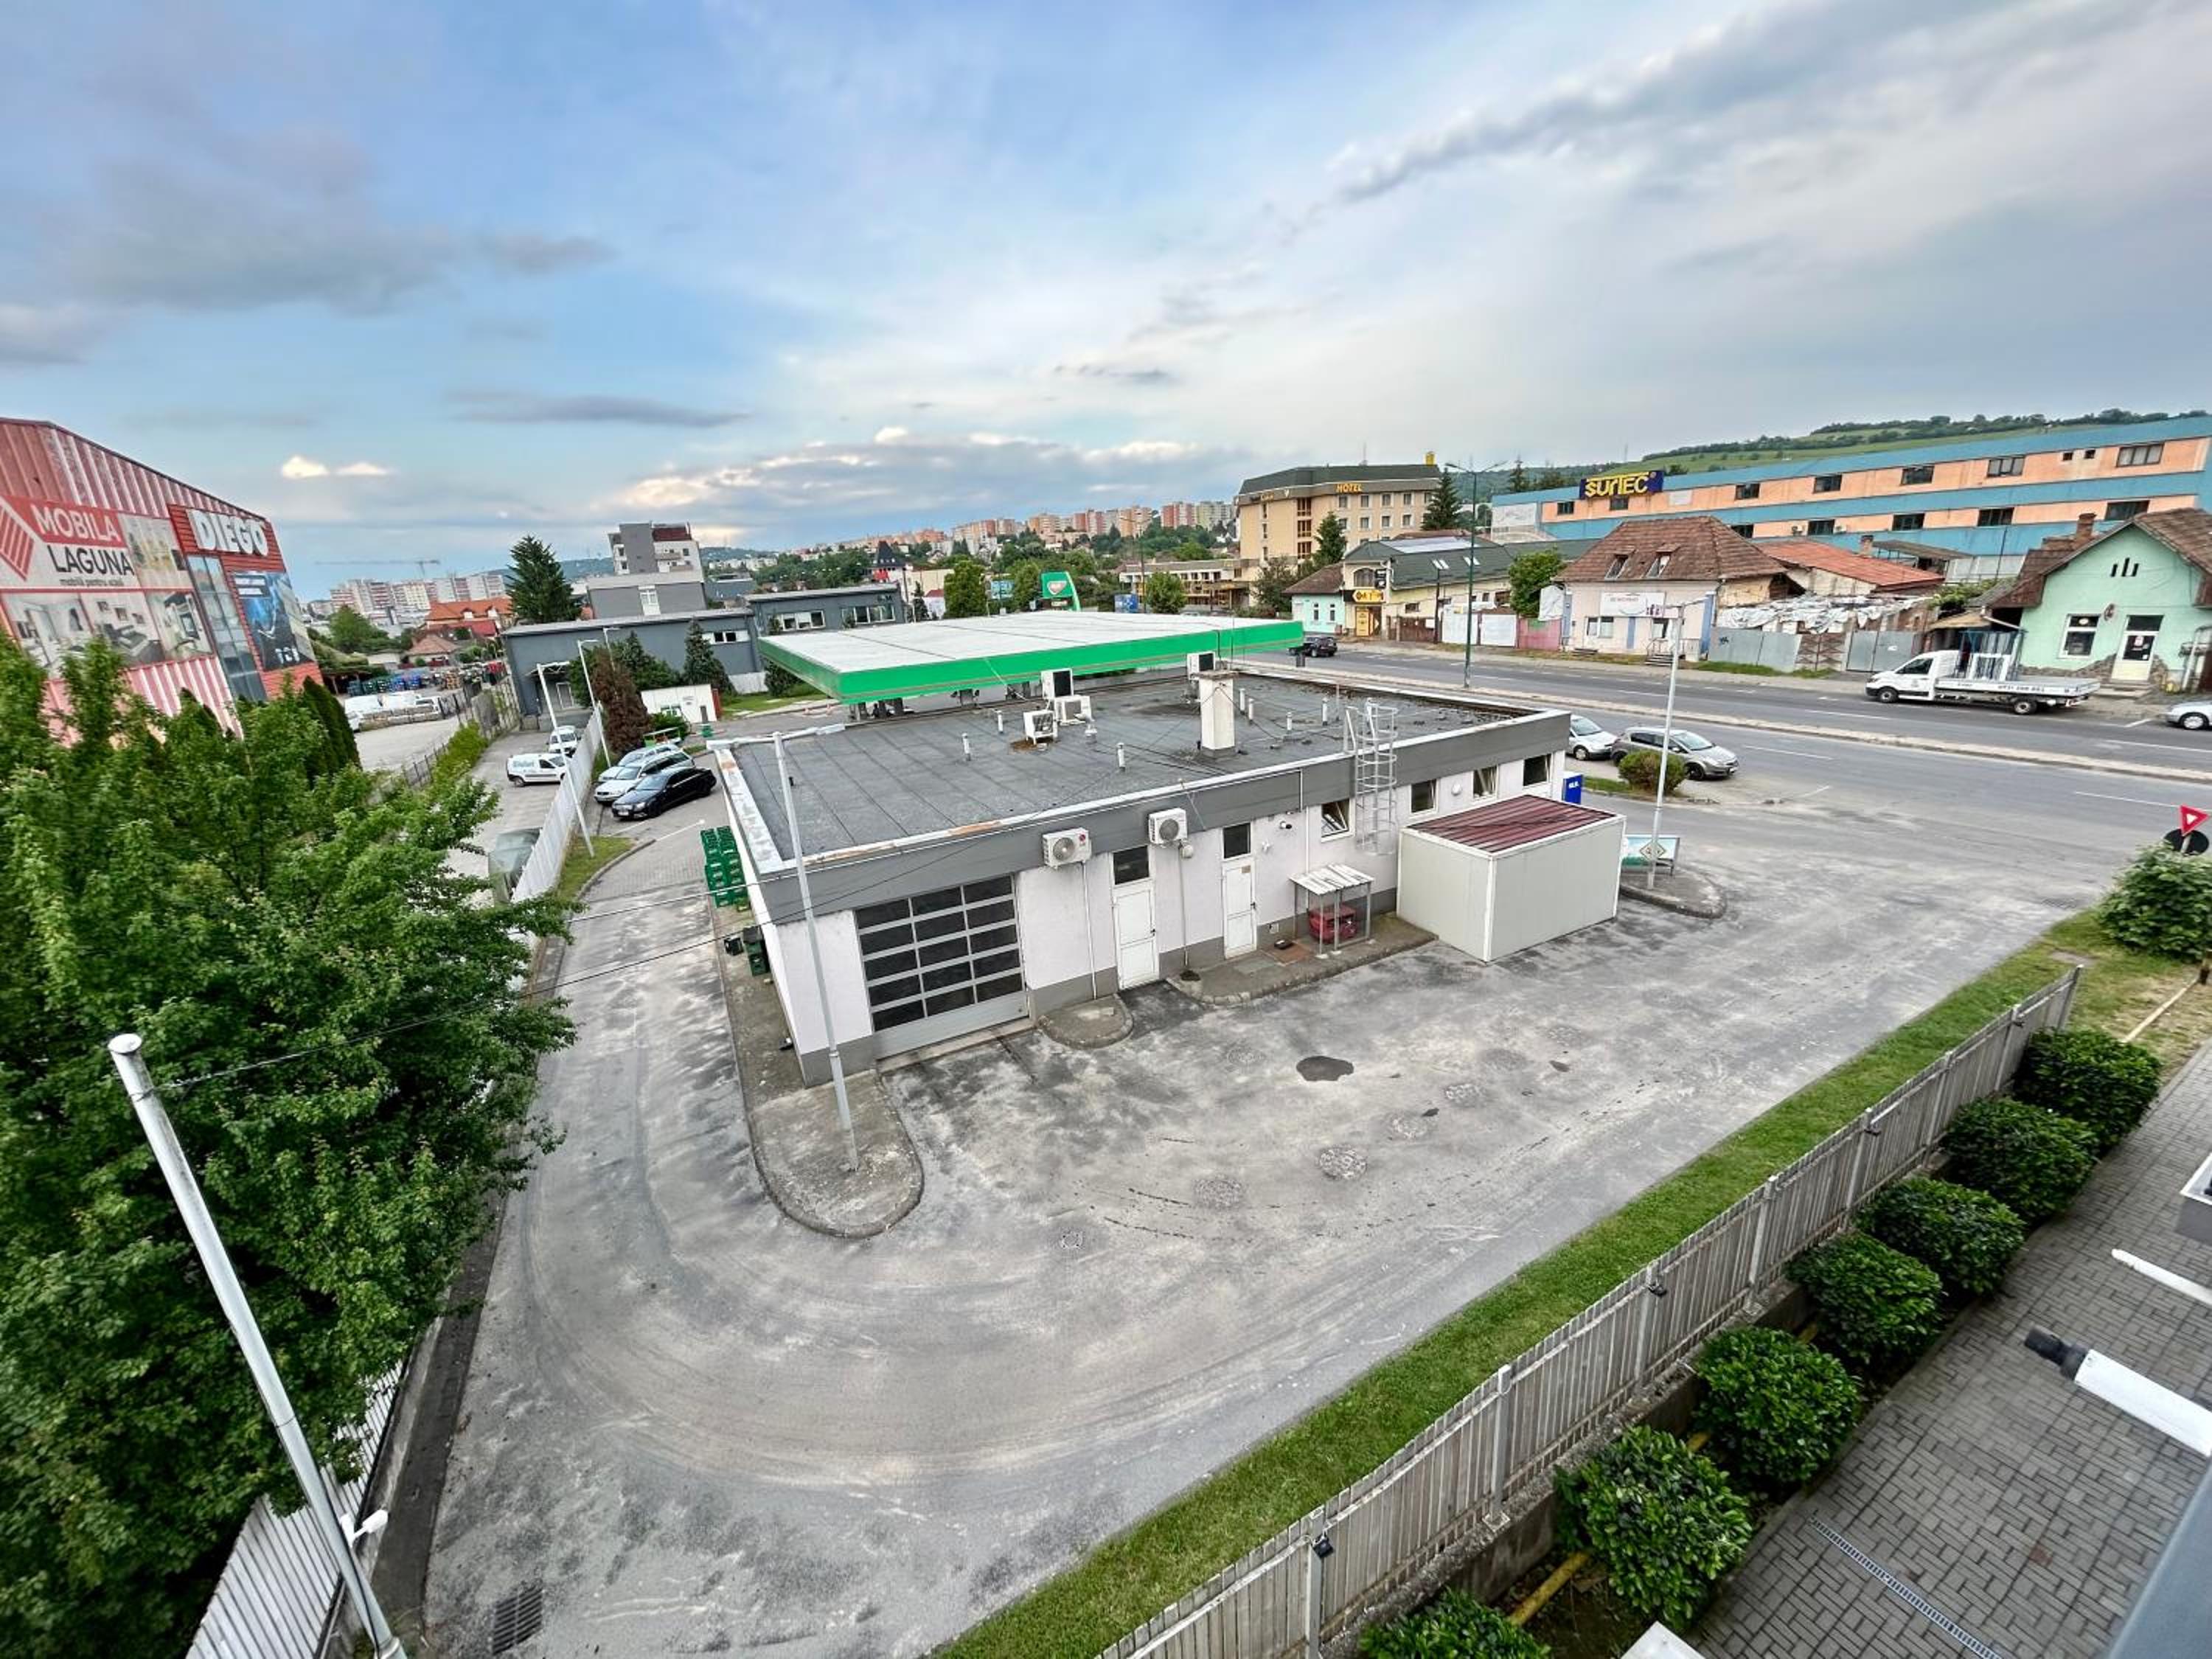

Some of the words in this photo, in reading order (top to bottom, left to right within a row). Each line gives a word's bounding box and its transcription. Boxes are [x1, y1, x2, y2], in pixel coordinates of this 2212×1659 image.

[1336, 483, 1363, 493] HOTEL
[30, 504, 122, 543] MOBILA
[187, 509, 268, 557] DIEGO
[47, 545, 135, 577] LAGUNA
